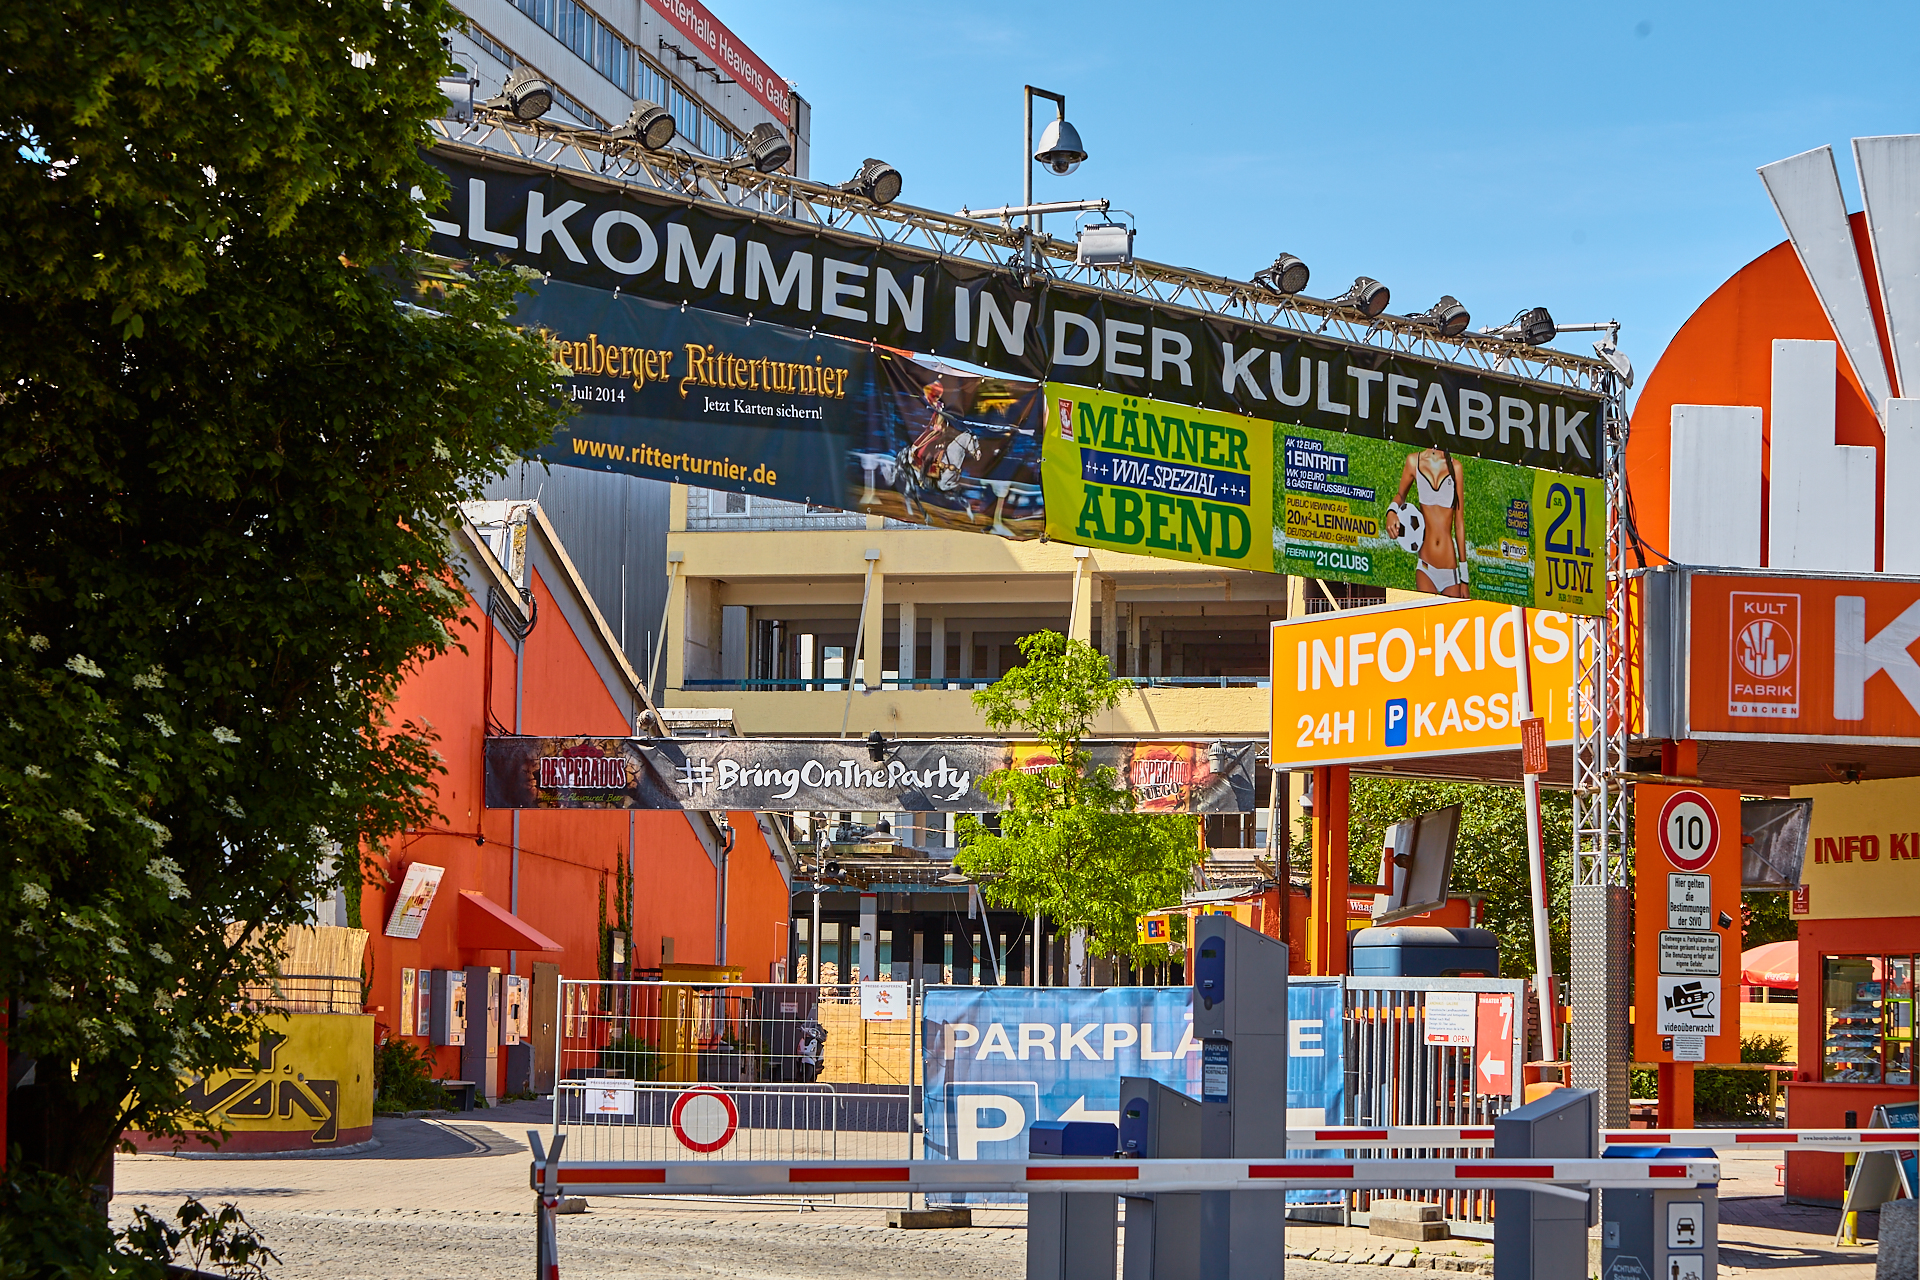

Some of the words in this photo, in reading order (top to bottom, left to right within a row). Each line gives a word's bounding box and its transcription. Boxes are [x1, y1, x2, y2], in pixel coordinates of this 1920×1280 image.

[659, 0, 716, 50] etterhalle
[719, 33, 763, 94] Heavens
[766, 78, 789, 115] Gate
[679, 343, 850, 400] Ritterturnier
[954, 286, 1032, 357] IN
[1053, 309, 1193, 387] DER
[1222, 341, 1592, 460] KULTFABRIK
[570, 384, 593, 402] Juli
[595, 386, 626, 403] 2014
[703, 396, 731, 413] Jetzt
[733, 398, 774, 417] Karten
[775, 403, 823, 420] sichern!
[1077, 397, 1251, 472] MÄNNER
[1286, 438, 1294, 448] AK
[1304, 441, 1322, 452] EURO
[572, 437, 777, 486] www.ritterturnier.de
[1294, 450, 1346, 473] EINTRITT
[1111, 457, 1218, 497] WM-SPEZIAL
[1307, 471, 1325, 482] EURO
[1320, 482, 1374, 499] FUSSBALL-TRIKOT
[1286, 498, 1309, 508] PUBLIC
[1310, 501, 1336, 512] VIEWING
[1336, 504, 1348, 513] AUF
[1508, 509, 1528, 520] SAMBA
[1513, 500, 1528, 510] SEXY
[1075, 483, 1252, 560] ABEND
[1507, 518, 1528, 529] SHOWS
[1545, 482, 1594, 558] 21.
[1286, 526, 1332, 540] DEUTSCHLAND
[1336, 532, 1356, 544] GHANA
[1286, 547, 1308, 558] FEIERN
[1316, 550, 1328, 566] 21
[1328, 552, 1370, 572] CLUBS
[1546, 556, 1594, 596] JUNI
[1744, 602, 1787, 615] KULT
[1734, 684, 1792, 697] FABRIK
[1730, 705, 1797, 715] MÜNCHEN
[1296, 709, 1355, 748] 24H
[1388, 704, 1404, 730] P
[540, 757, 626, 788] DESPERADOS
[676, 756, 970, 801] #BringOnTheParty
[1674, 815, 1704, 851] 10
[1814, 834, 1880, 864] INFO
[1674, 877, 1686, 888] Hier
[1688, 878, 1705, 890] gelten
[1686, 892, 1694, 902] die
[1670, 902, 1710, 916] Bestimmungen
[1678, 916, 1688, 926] der
[1688, 916, 1702, 926] StVO
[1664, 1022, 1714, 1032] videoüberwacht
[1452, 1034, 1470, 1043] OPEN
[956, 1094, 1026, 1161] P
